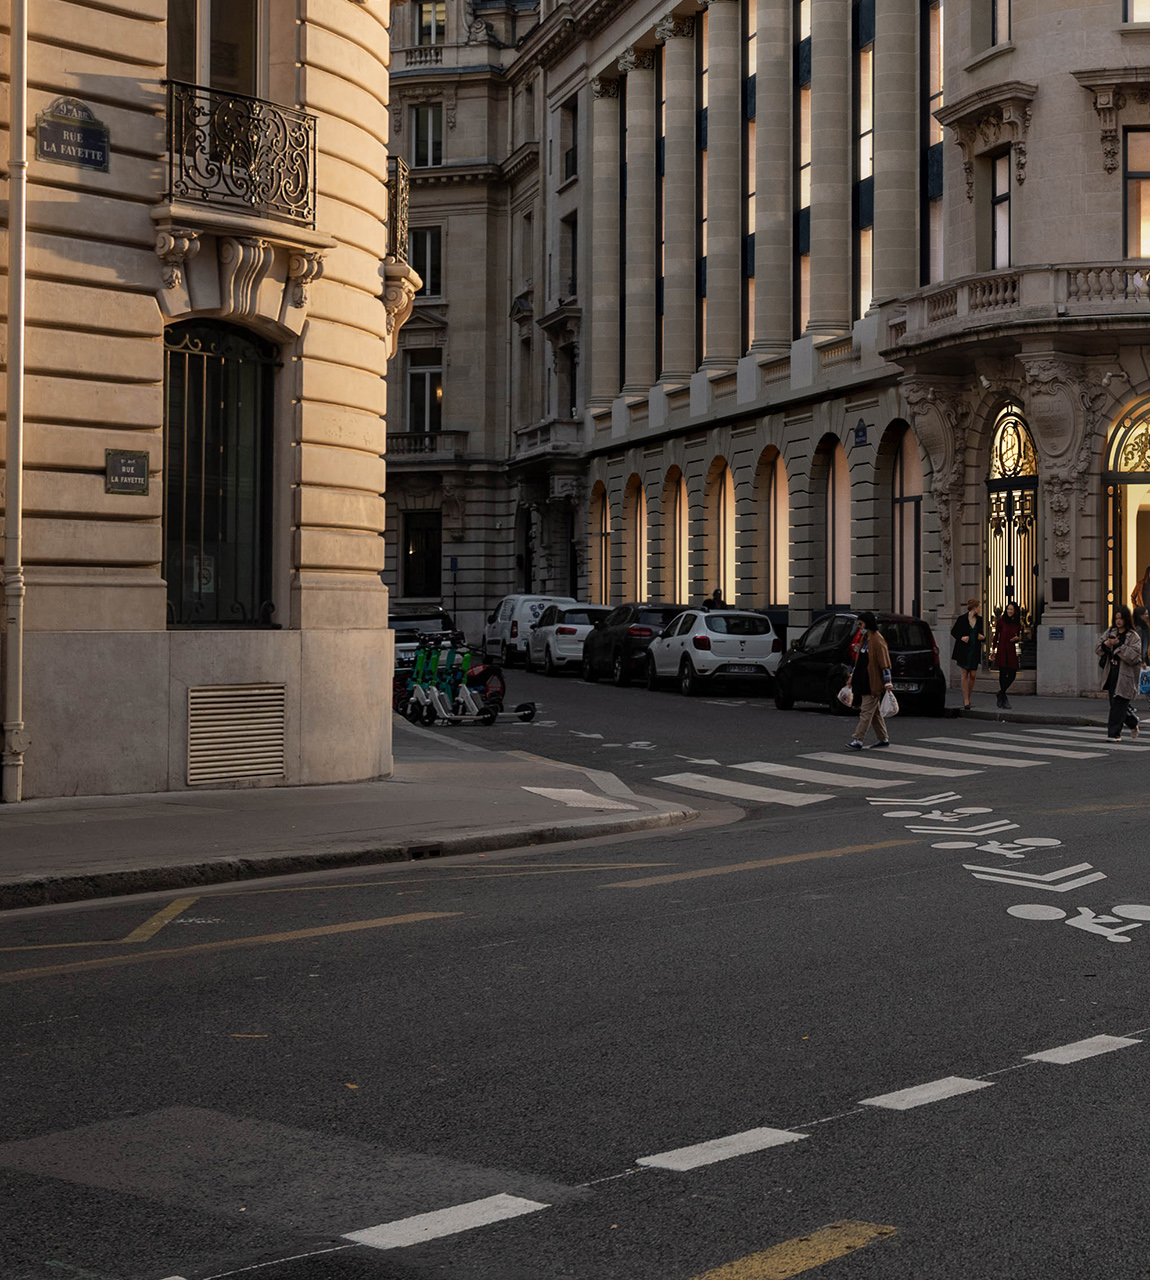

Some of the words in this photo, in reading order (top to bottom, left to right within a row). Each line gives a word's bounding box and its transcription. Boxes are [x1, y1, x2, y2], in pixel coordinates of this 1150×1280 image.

[63, 130, 83, 143] RUE
[43, 141, 57, 153] LA
[61, 144, 103, 160] FAYETTE
